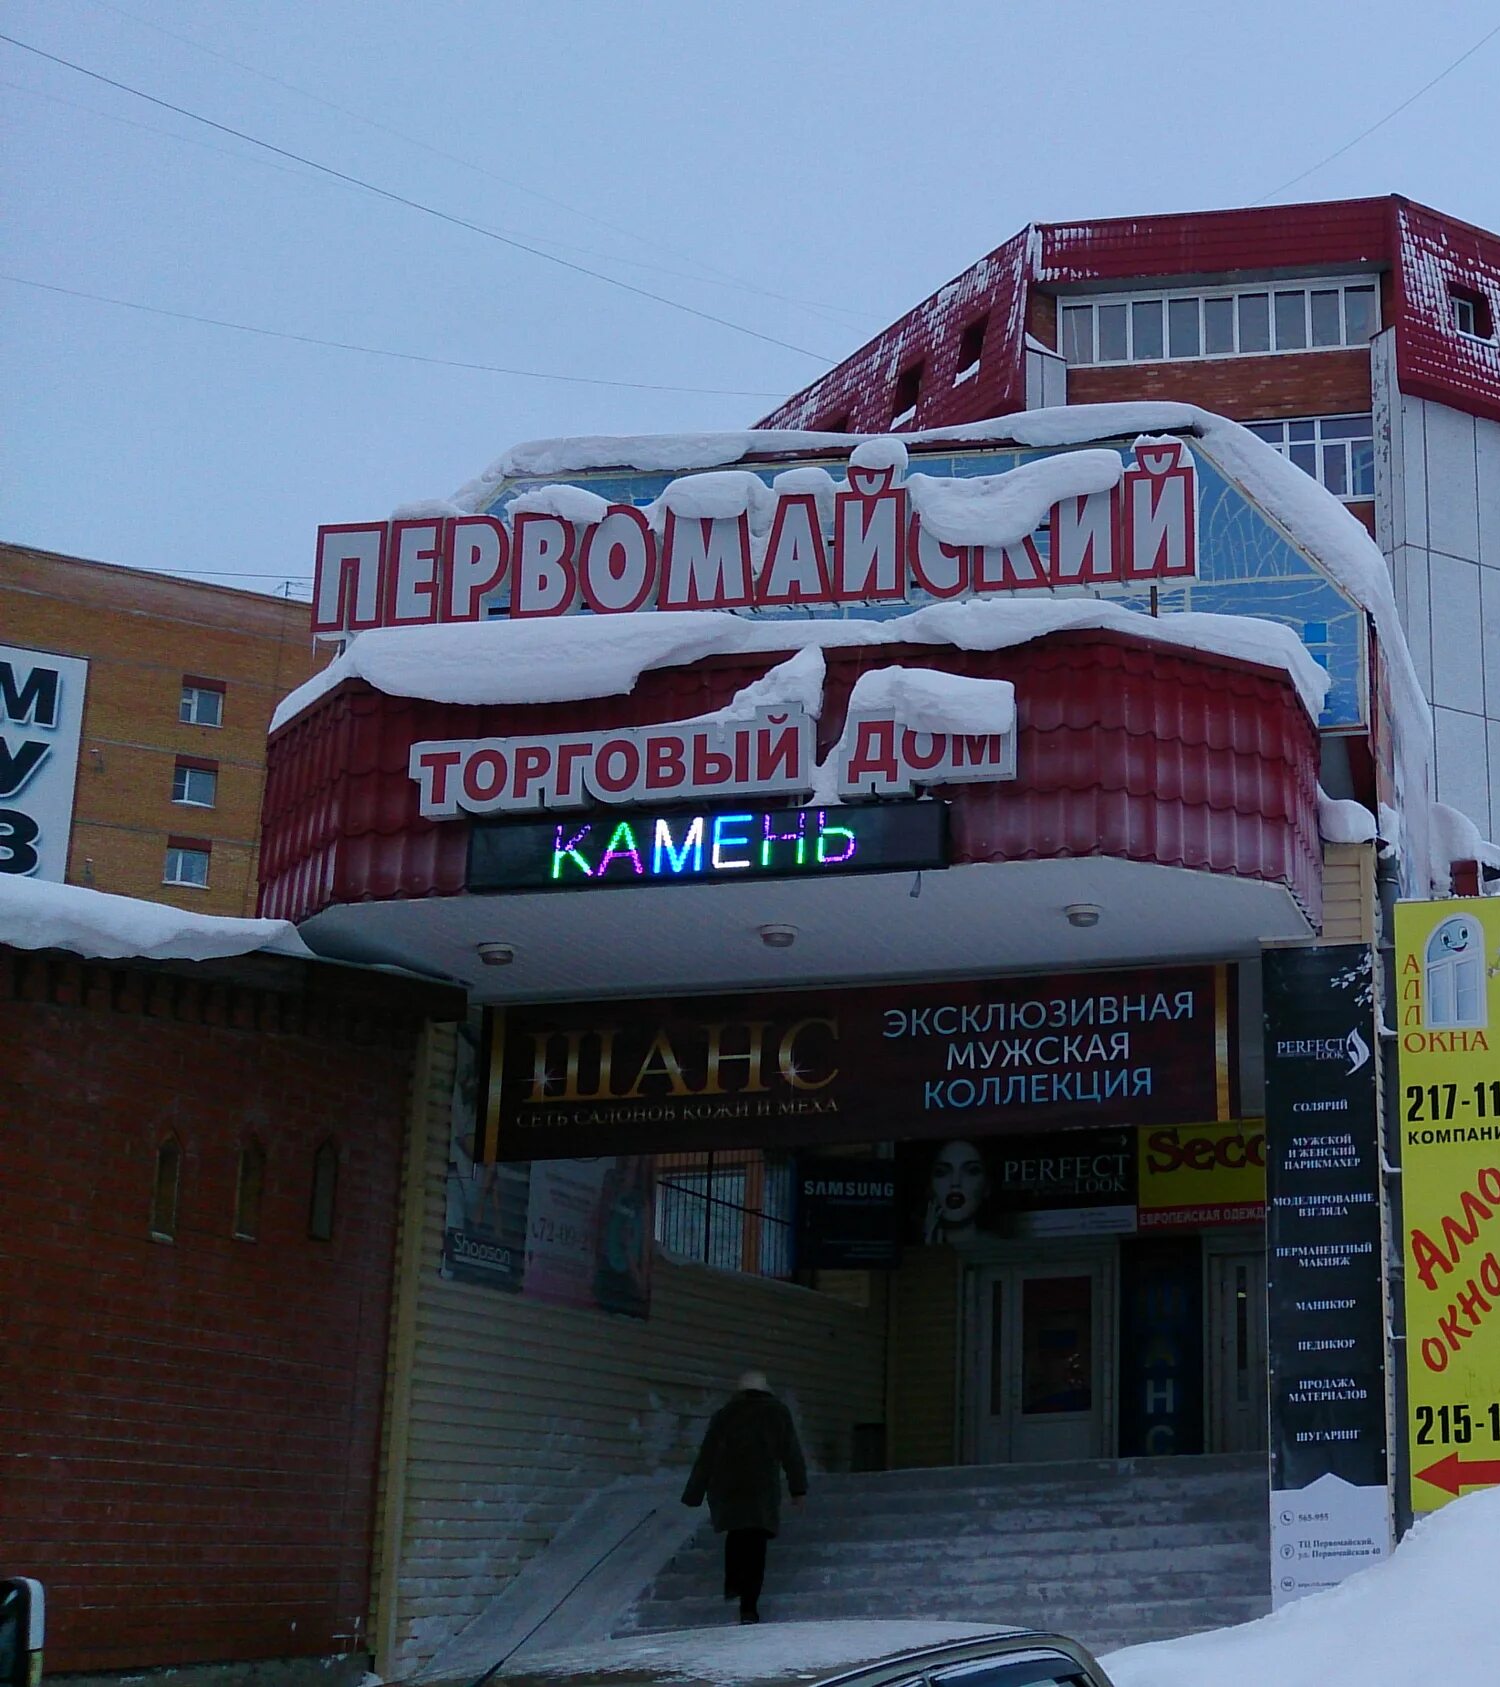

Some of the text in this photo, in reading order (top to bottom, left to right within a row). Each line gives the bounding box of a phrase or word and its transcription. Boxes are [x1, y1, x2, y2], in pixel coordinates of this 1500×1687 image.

[420, 713, 1000, 804] ТОРГОВЫЙ ДОМ
[550, 812, 857, 881] КАМЕНЬ
[883, 991, 1194, 1039] ЭКСКЛЮЗИВНАЯ
[946, 1032, 1130, 1071] МУЖСКАЯ
[1277, 1039, 1345, 1054] PERFECT
[521, 1017, 840, 1101] ШАНС
[1316, 1051, 1344, 1060] LOOK
[924, 1068, 1152, 1109] КОЛЛЕКЦИЯ
[1293, 1099, 1348, 1112] СОЛЯРИЙ
[515, 1098, 840, 1127] СЕТЬ САЛОНОВ КОЖИ И МЕХА
[1292, 1134, 1351, 1146] МУЖСКОЙ
[1288, 1145, 1356, 1158] И ЖЕНСКИЙ
[1003, 1153, 1131, 1182] PERFECT
[1285, 1158, 1360, 1170] ПАРИКМАХЕР
[804, 1180, 894, 1197] SAMSUNG
[1074, 1177, 1129, 1194] LOOK
[1273, 1193, 1374, 1206] МОДЕЛИРОВАНИЕ
[1299, 1206, 1348, 1217] ВЗГЛЯДА
[1276, 1242, 1372, 1257] ПЕРМАНЕНТНЫЙ
[1299, 1256, 1350, 1268] МАКИЯЖ
[1296, 1299, 1356, 1311] МАНИКЮР
[1298, 1339, 1355, 1351] ПЕДИКЮР
[1299, 1379, 1355, 1390] ПРОДАЖА
[1289, 1389, 1367, 1402] МАТЕРИАЛОВ
[1296, 1429, 1361, 1442] ШУГАРИНГ
[1312, 1549, 1369, 1560] Первомайская
